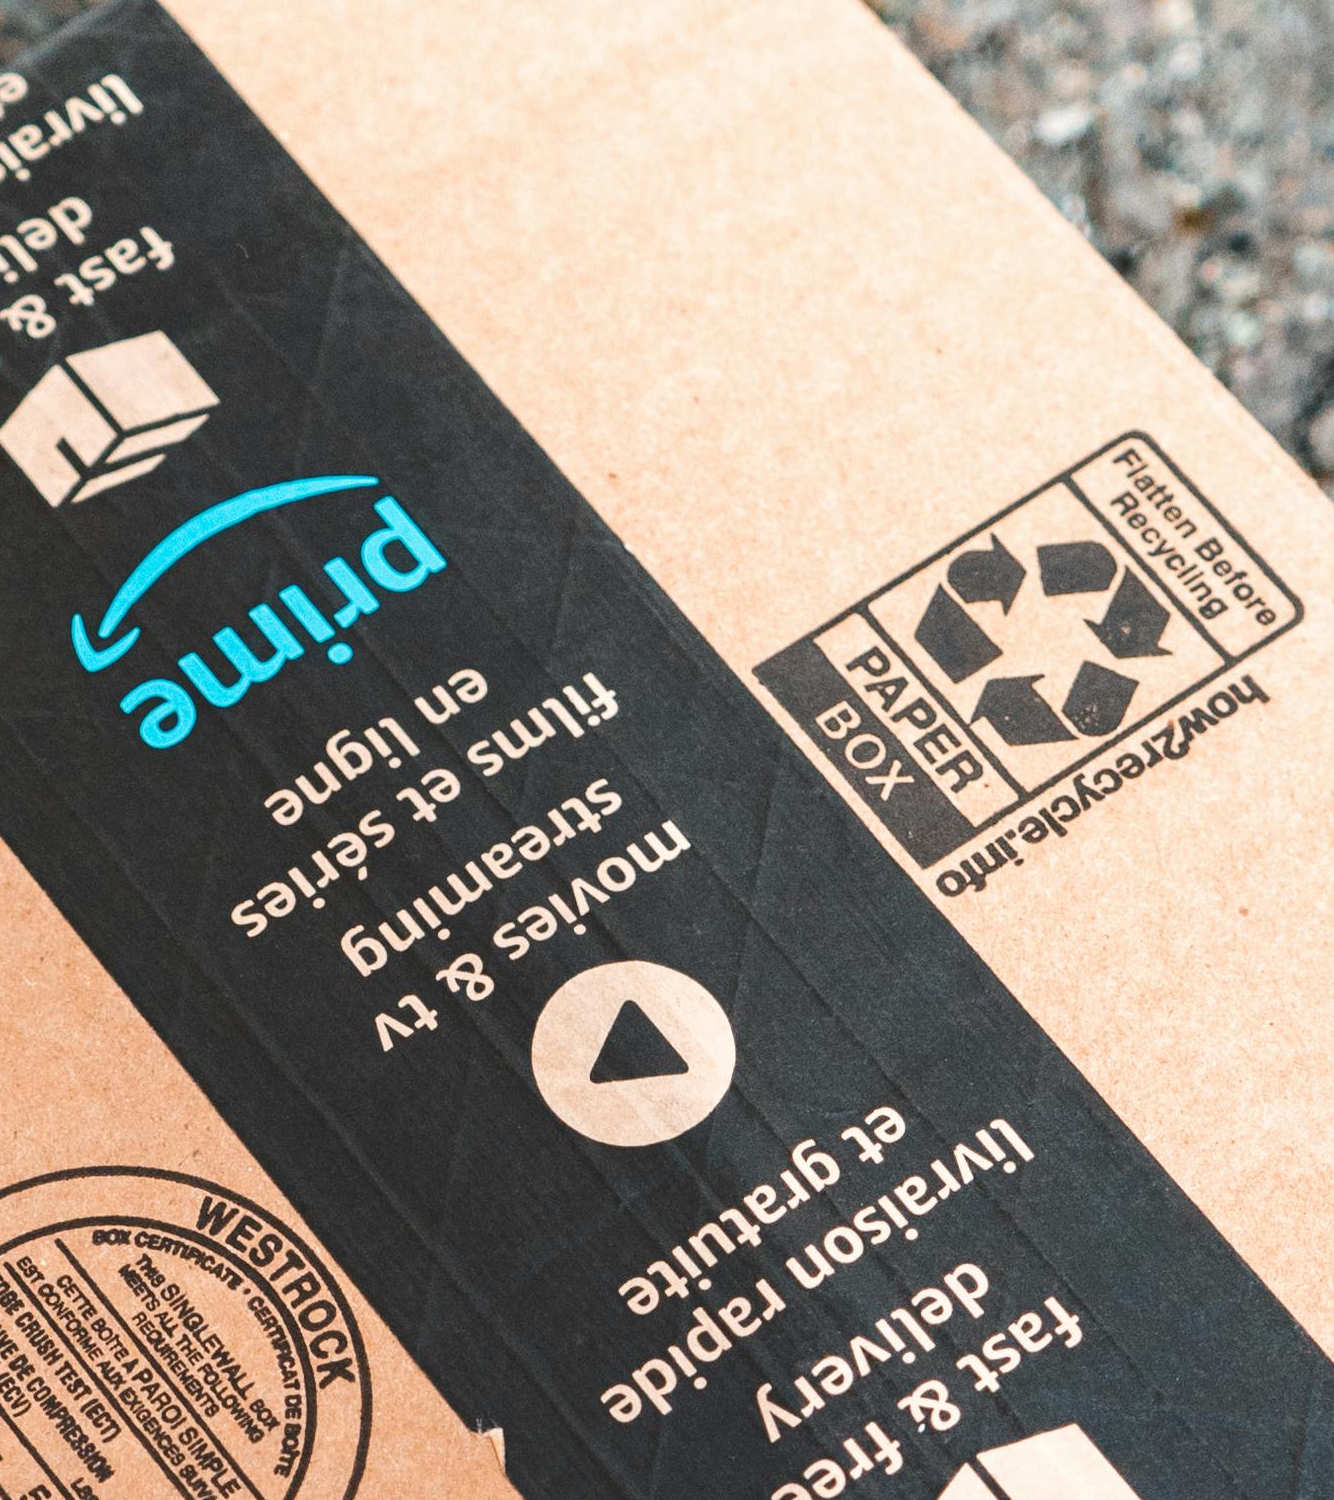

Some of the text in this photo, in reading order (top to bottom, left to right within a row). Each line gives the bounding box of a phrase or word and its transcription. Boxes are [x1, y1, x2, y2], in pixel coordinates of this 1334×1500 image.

[54, 227, 174, 305] fast
[120, 496, 446, 748] prime
[1111, 491, 1228, 620] Recycling
[1113, 448, 1276, 626] Flatten Before
[231, 673, 618, 937] films et séries
[264, 669, 487, 825] en ligne
[816, 701, 914, 801] BOX
[846, 646, 983, 793] PAPER
[936, 675, 1270, 897] how2recycle.info
[341, 779, 622, 976] streaming
[375, 820, 691, 1051] movies & tv
[196, 1196, 355, 1389] WESTROCK
[601, 1119, 1034, 1422] livraison rapide
[619, 1107, 905, 1314] et gratuite
[15, 1312, 63, 1365] CRUSH
[55, 1361, 92, 1400] TEST
[80, 1399, 121, 1443] (ECT)
[17, 1256, 45, 1283] EST
[38, 1284, 103, 1361] CONFORME
[97, 1361, 126, 1390] AUX
[119, 1387, 185, 1466] EXIGENCES
[57, 1275, 97, 1321] CETTE
[131, 1368, 187, 1430] PAROI
[179, 1427, 241, 1499] SIMPLE
[92, 1229, 131, 1245] BOX
[134, 1232, 244, 1290] CERTIFICATE
[248, 1296, 300, 1389] CERTIFICAT
[285, 1394, 302, 1419] DE
[118, 1264, 264, 1443] MEETS ALL THE FOLLOWING
[132, 1312, 219, 1417] REQUIREMENTS
[136, 1254, 280, 1432] THIS SINGLEWALL BOX
[757, 1264, 988, 1442] delivery
[898, 1380, 960, 1432] &
[956, 1297, 1082, 1392] fast
[9, 1354, 35, 1381] DE
[27, 1377, 114, 1483] COMPRESSION
